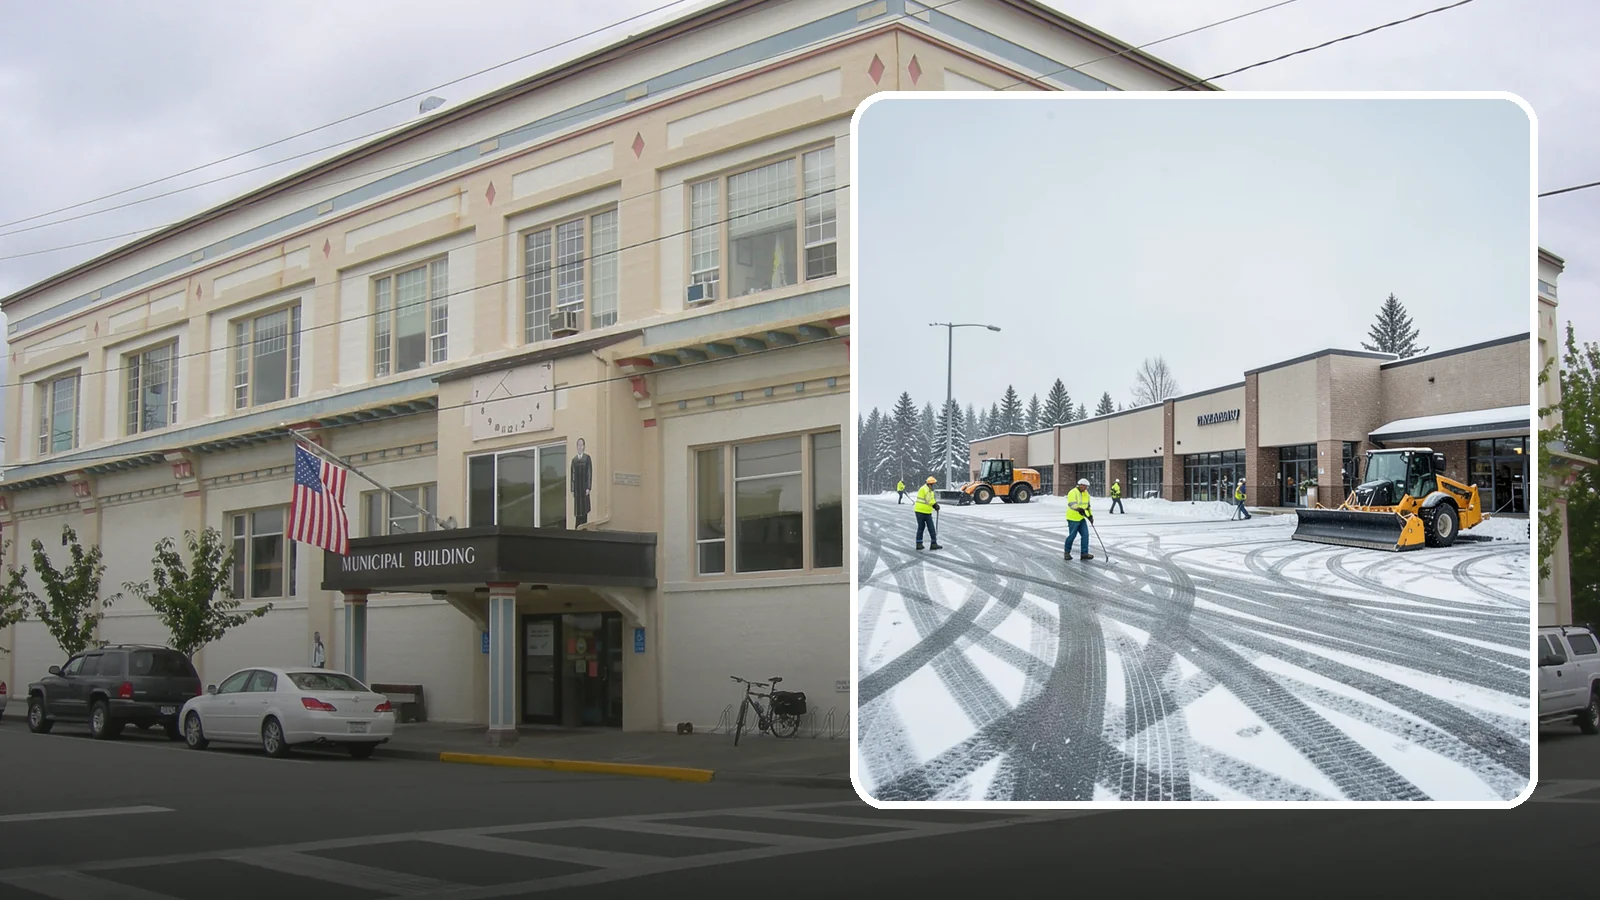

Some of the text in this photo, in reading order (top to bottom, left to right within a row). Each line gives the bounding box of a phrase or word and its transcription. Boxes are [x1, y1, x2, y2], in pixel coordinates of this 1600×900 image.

[488, 417, 492, 426] 9
[508, 425, 513, 433] 12
[521, 420, 526, 428] 2
[528, 414, 532, 422] 3
[342, 546, 475, 572] MUNICIPAL BUILDING
